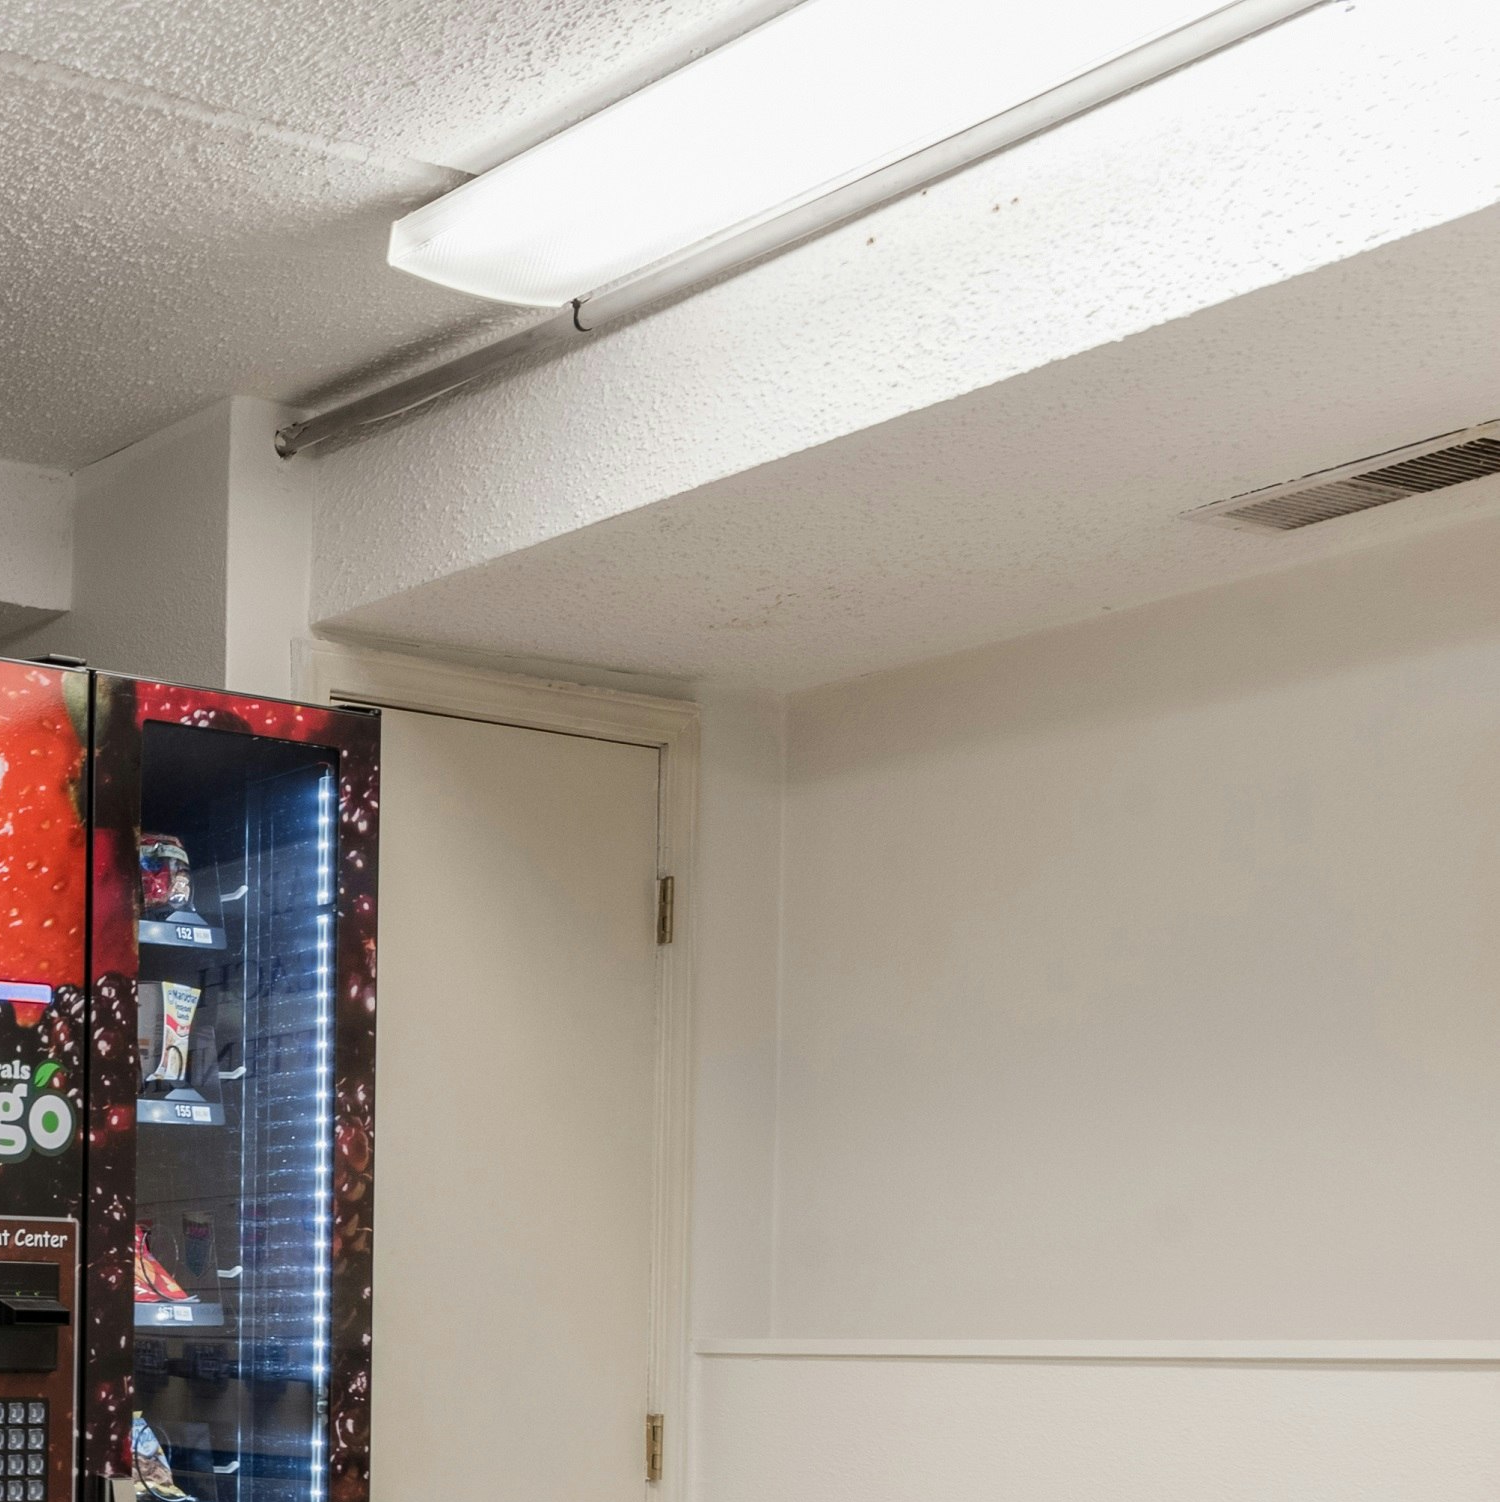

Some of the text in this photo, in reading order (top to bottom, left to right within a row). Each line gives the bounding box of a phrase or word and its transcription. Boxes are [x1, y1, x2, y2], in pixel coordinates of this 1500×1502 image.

[176, 927, 192, 940] 152
[175, 1105, 192, 1118] 155
[14, 1228, 68, 1249] Center
